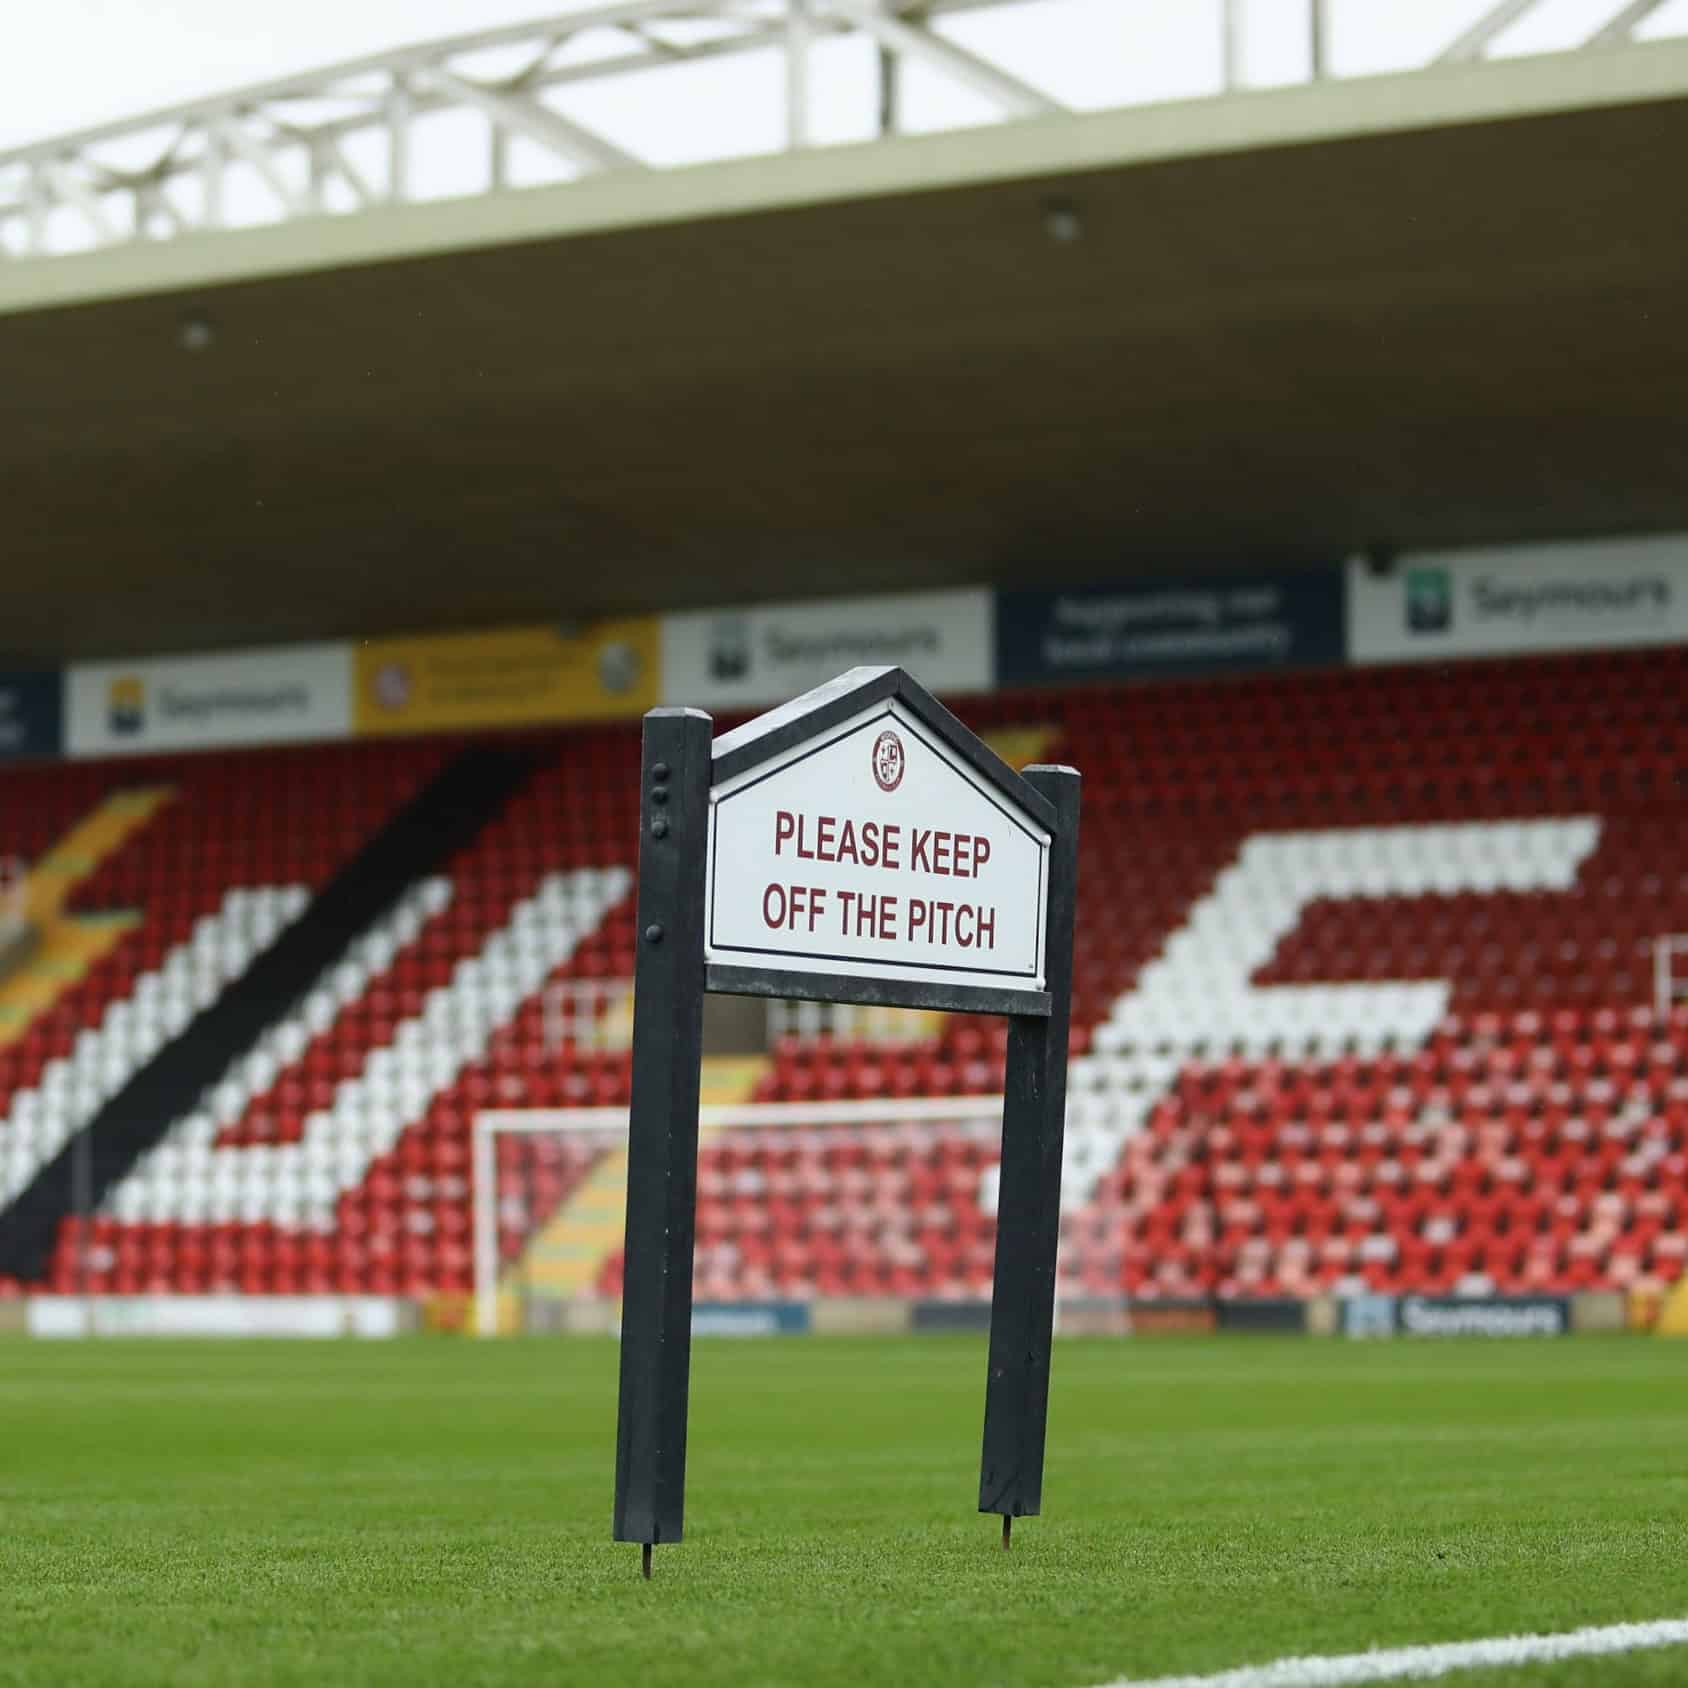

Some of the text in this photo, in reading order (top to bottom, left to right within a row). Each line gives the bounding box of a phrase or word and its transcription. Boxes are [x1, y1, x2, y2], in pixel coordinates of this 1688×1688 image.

[775, 811, 991, 878] PLEASE KEEP
[763, 883, 995, 949] OFF THE PITCH
